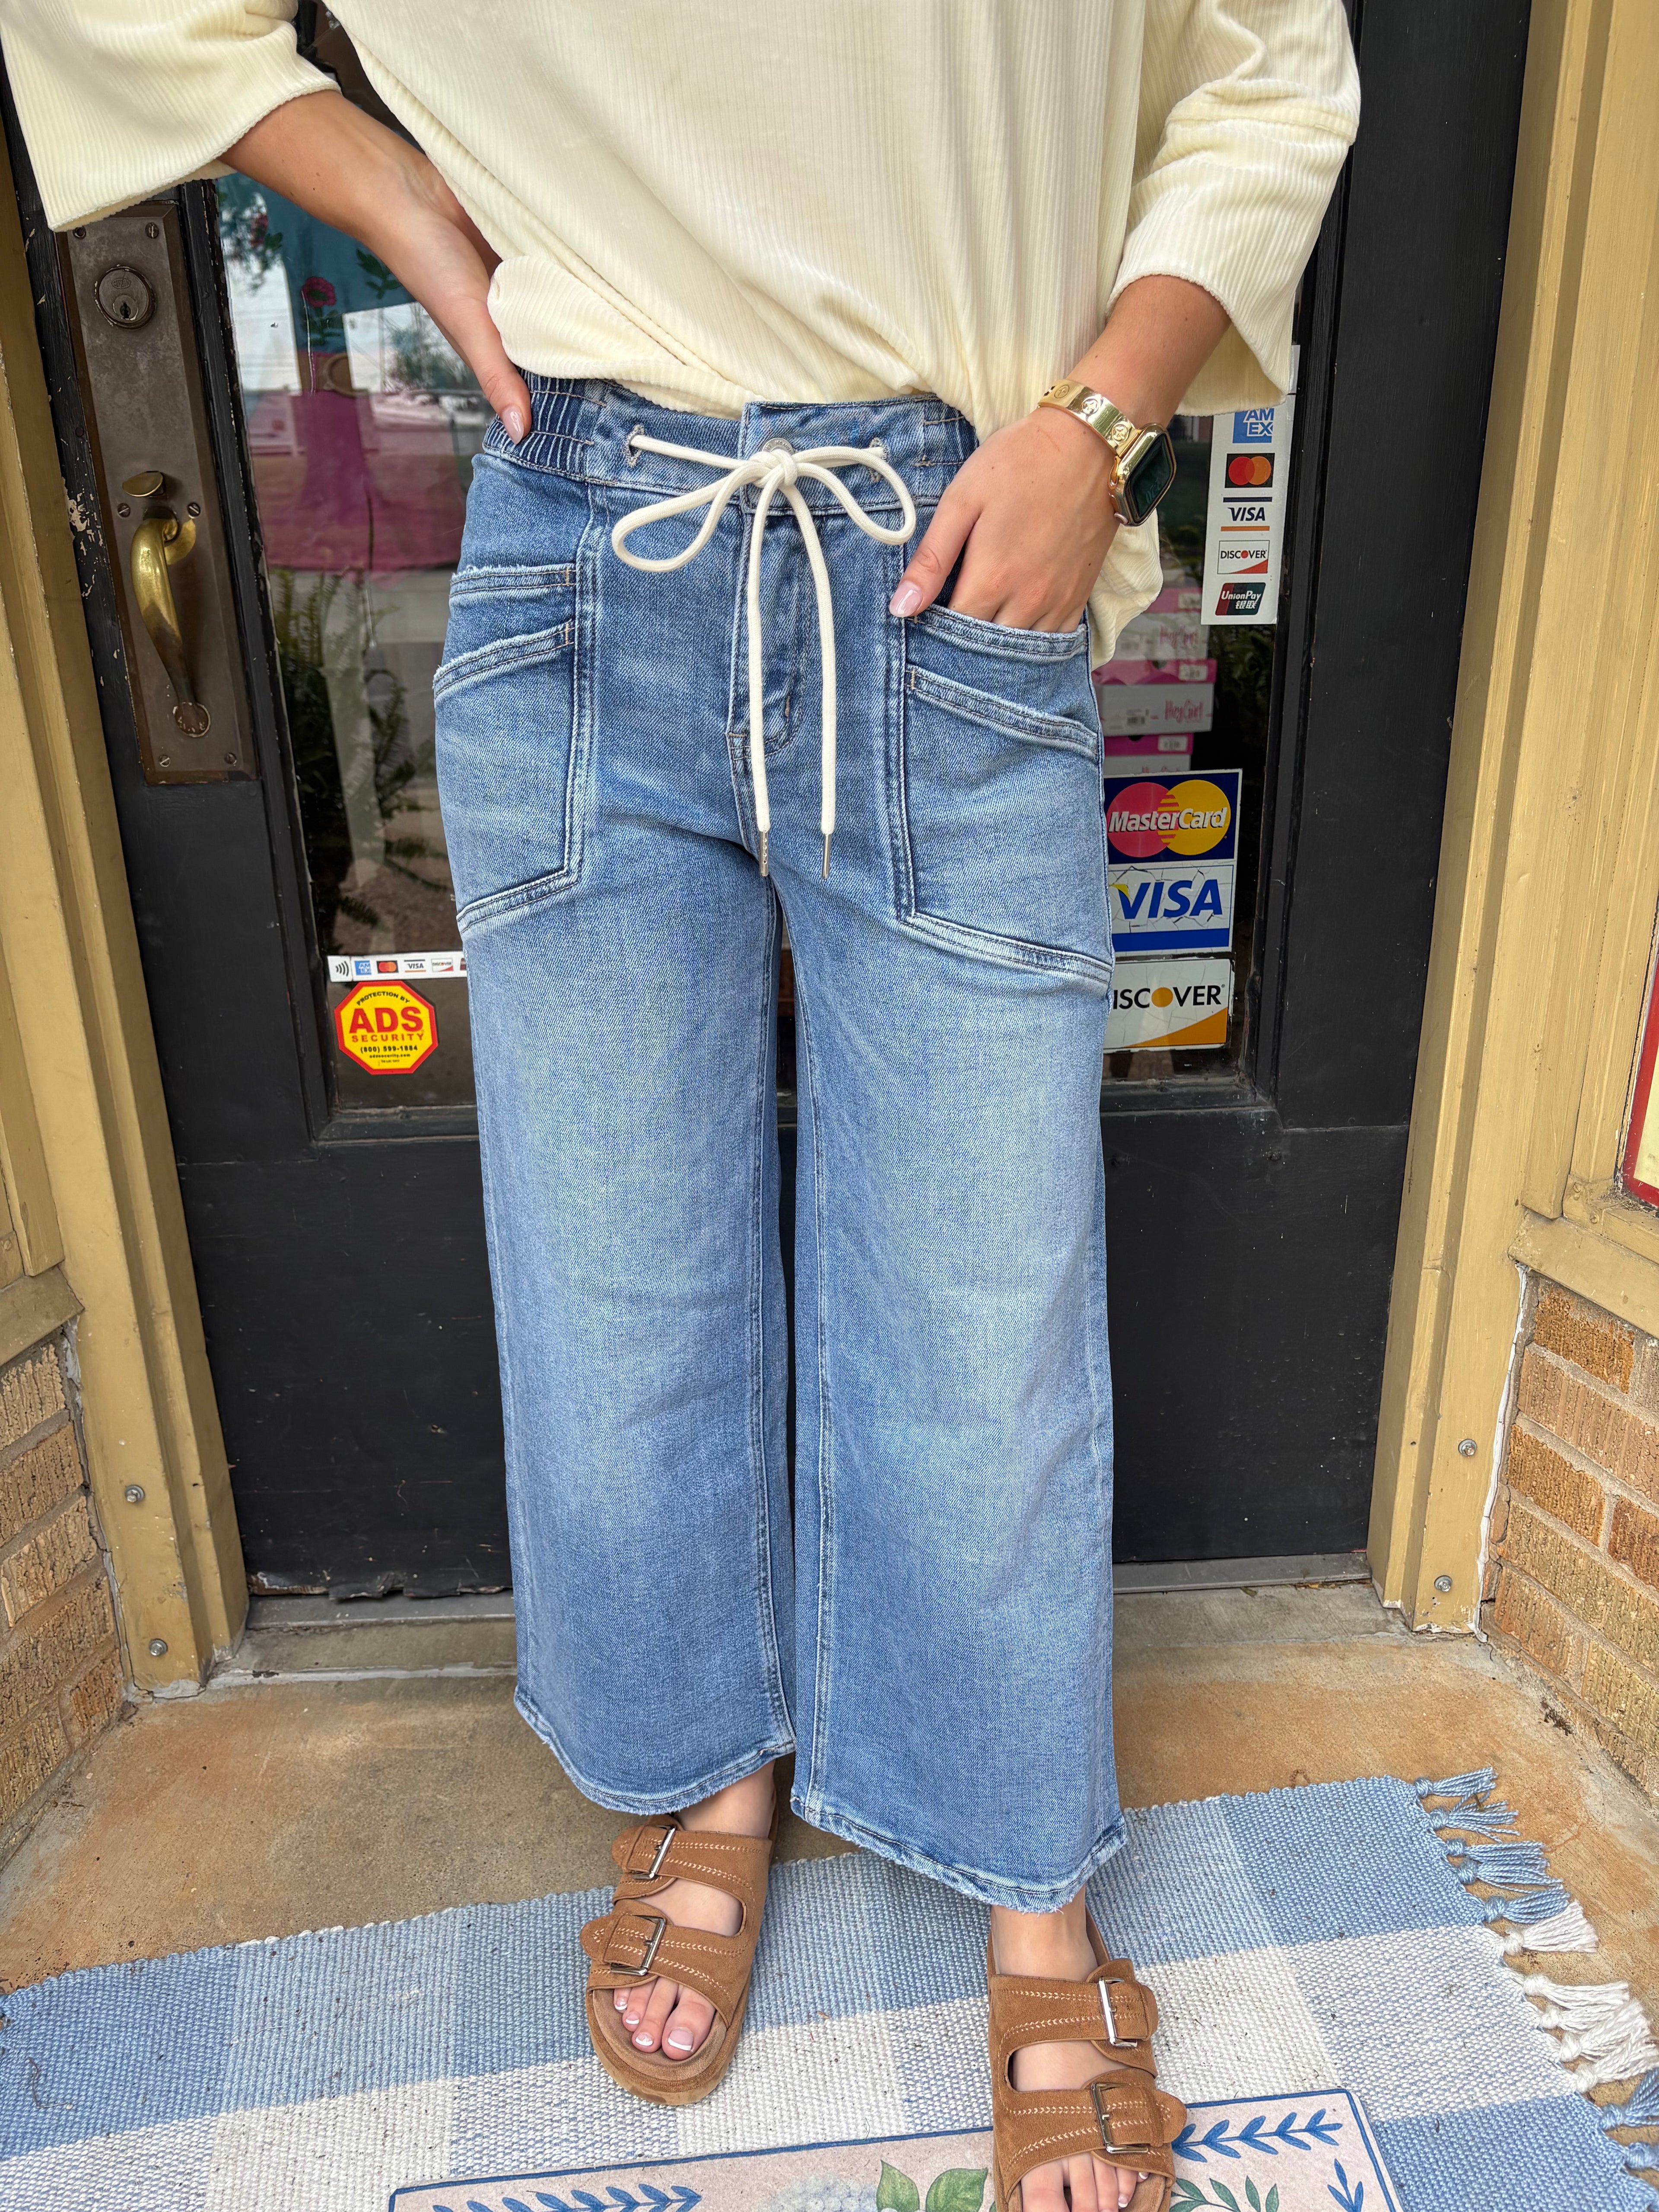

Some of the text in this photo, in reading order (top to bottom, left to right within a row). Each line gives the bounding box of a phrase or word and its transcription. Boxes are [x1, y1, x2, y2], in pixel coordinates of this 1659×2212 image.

[1244, 408, 1274, 422] AM
[1247, 422, 1273, 436] EX
[1227, 507, 1265, 521] VISA
[1220, 550, 1266, 559] DISCOVER
[1221, 591, 1261, 602] UnionPay
[1109, 807, 1227, 832] MasterCard
[1109, 879, 1223, 919] VISA
[356, 991, 398, 1006] PROTECTION
[1113, 985, 1222, 1009] ISCOVER
[349, 1006, 423, 1033] ADS
[352, 1033, 424, 1042] SECURITY
